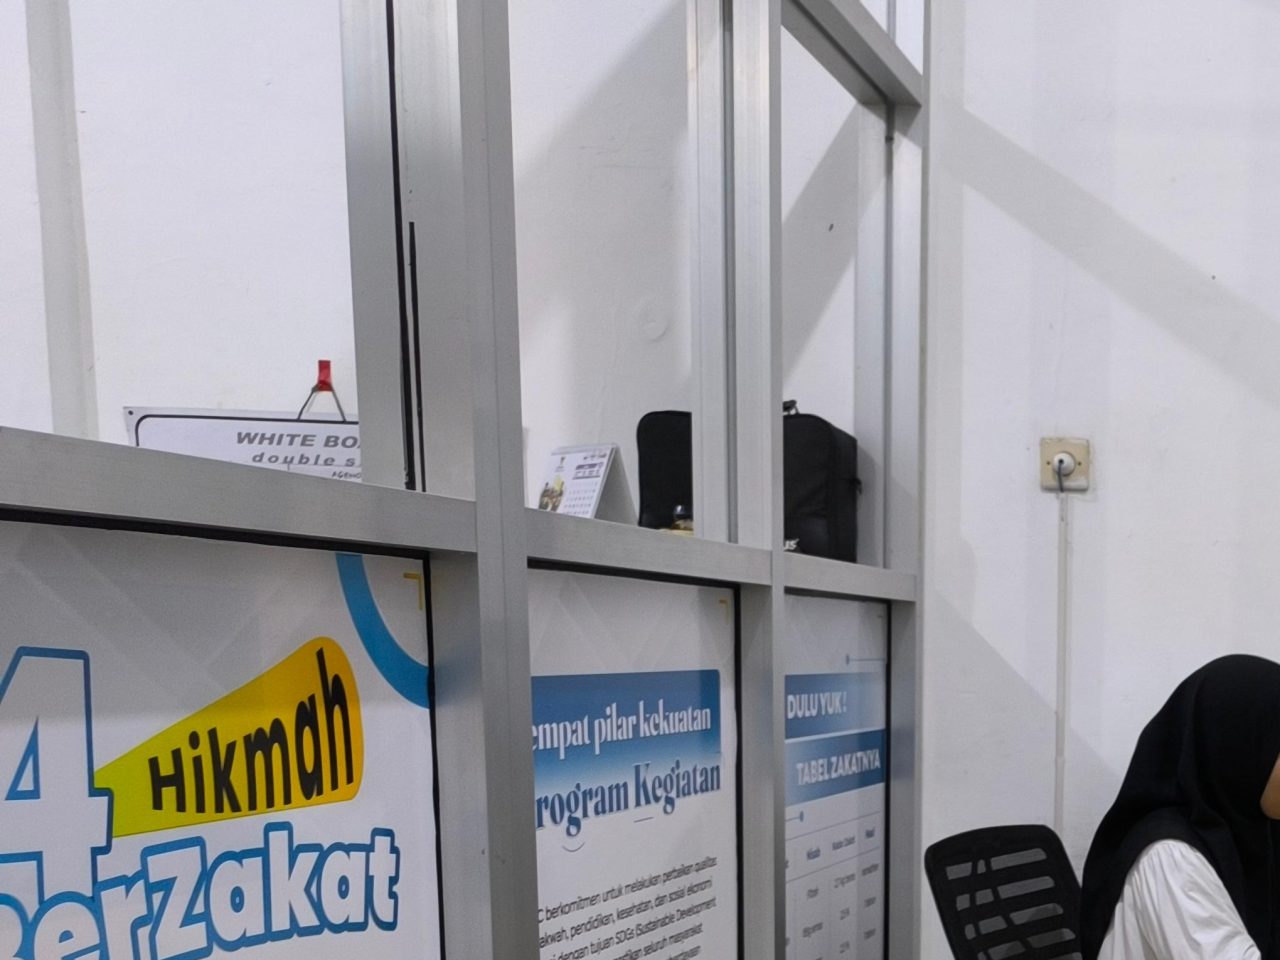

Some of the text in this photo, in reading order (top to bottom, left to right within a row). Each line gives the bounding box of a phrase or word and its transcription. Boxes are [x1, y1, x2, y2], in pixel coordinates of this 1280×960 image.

[237, 432, 317, 447] WHITE
[251, 451, 335, 466] double
[787, 693, 818, 719] DULU
[594, 702, 637, 755] pilar
[639, 699, 711, 738] kekuatan
[0, 646, 355, 904] 4 Hikmah
[796, 749, 881, 786] TABEL ZAKATNYA
[536, 759, 721, 837] rogram Kegiatan
[546, 894, 601, 921] berkomitmen
[602, 884, 623, 902] untuk
[539, 927, 569, 948] akwah,
